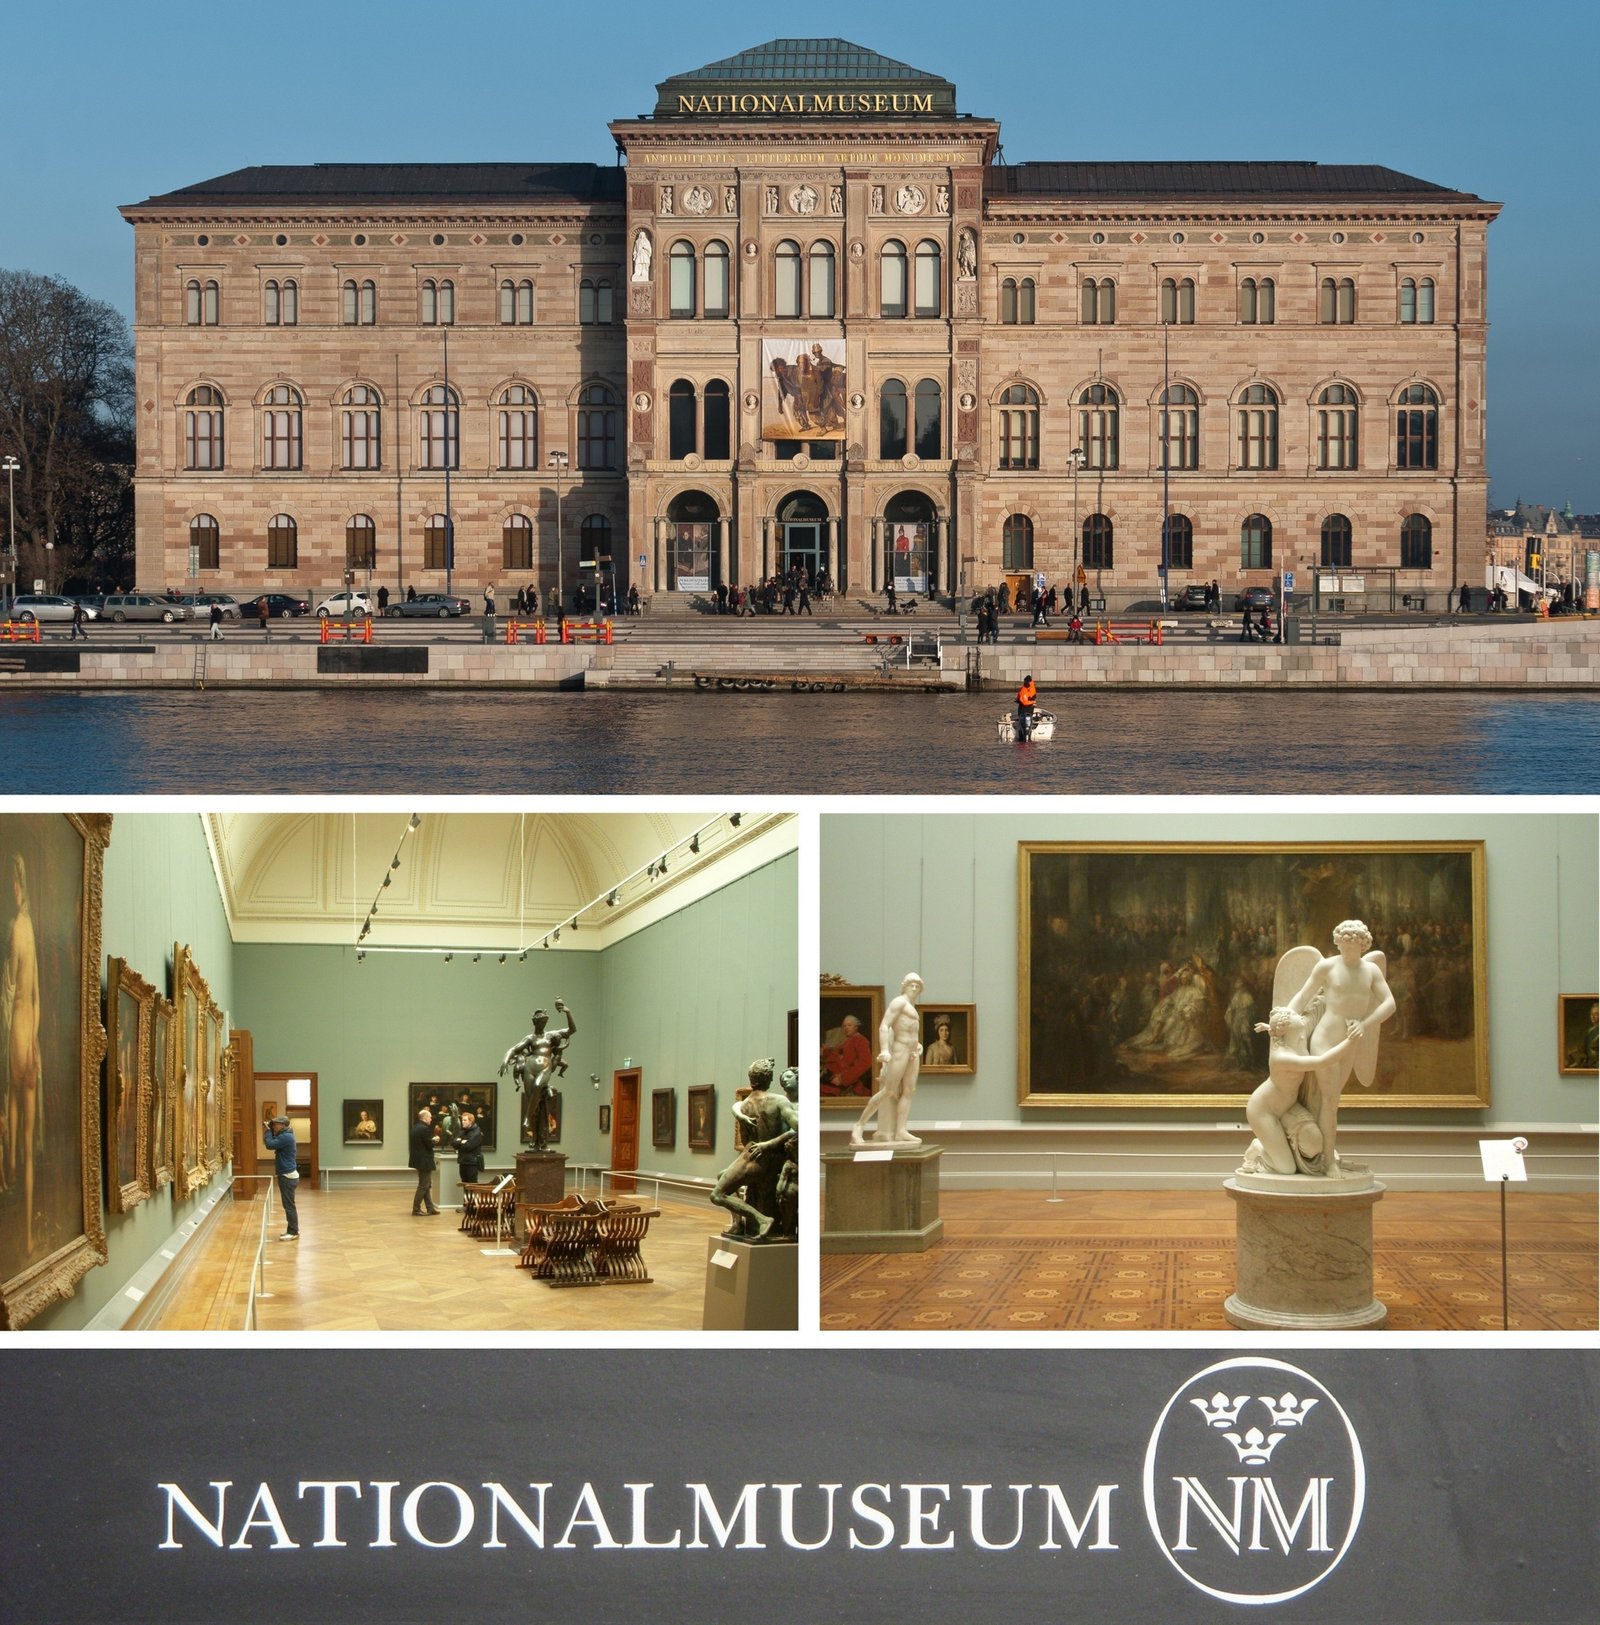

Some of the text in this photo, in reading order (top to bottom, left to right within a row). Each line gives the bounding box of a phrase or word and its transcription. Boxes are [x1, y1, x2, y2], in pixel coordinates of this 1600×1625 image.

[678, 94, 934, 113] NATIONALMUSEUM
[157, 1476, 1334, 1556] NATIONALMUSEUM NM
